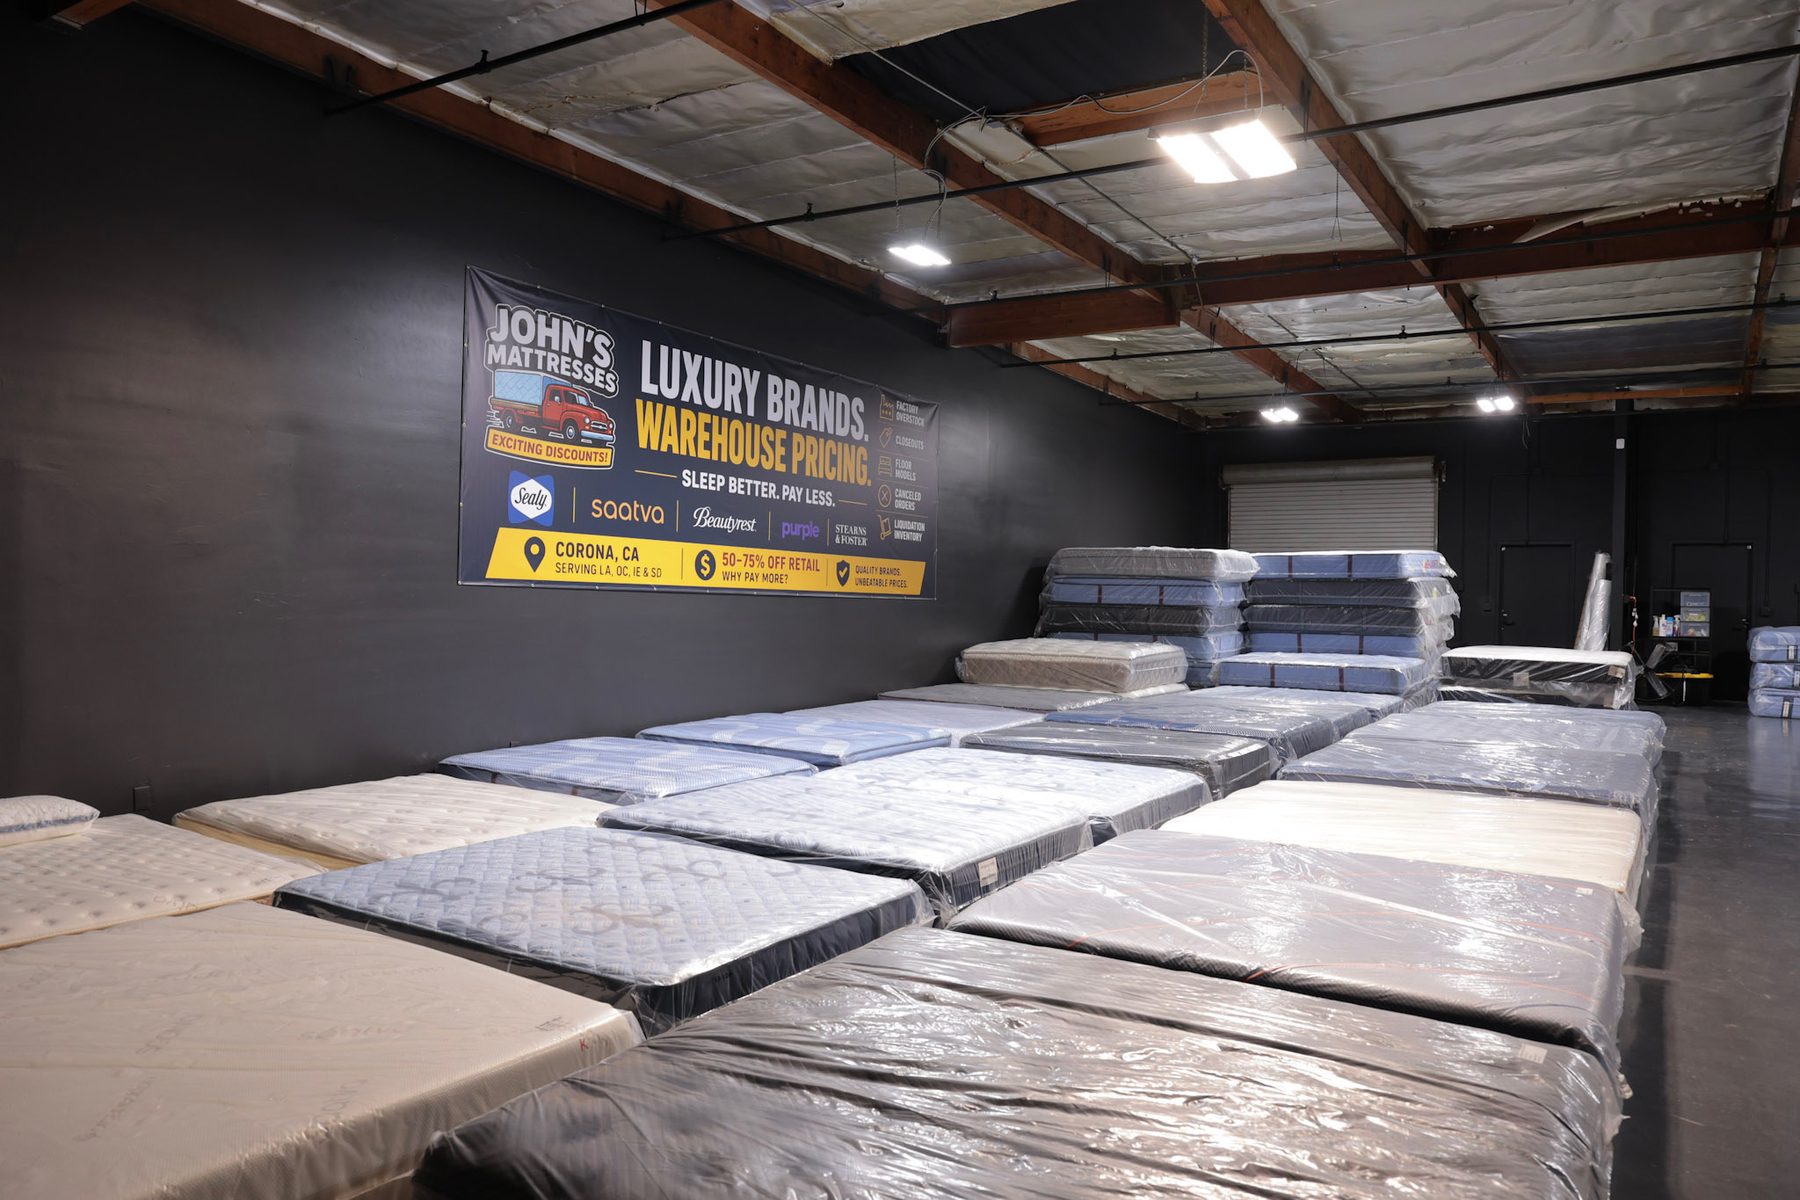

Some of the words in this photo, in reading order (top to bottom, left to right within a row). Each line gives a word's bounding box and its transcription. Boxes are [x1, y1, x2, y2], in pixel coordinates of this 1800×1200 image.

[490, 308, 611, 368] JOHN'S
[487, 344, 616, 393] MATTRESSES
[641, 340, 760, 417] LUXURY
[767, 373, 869, 442] BRANDS.
[896, 400, 919, 414] FACTORY
[896, 412, 925, 427] OVERSTOCK
[492, 434, 542, 456] EXCITING
[546, 447, 608, 463] DISCOUNTS!
[635, 398, 787, 472] WAREHOUSE
[792, 432, 872, 486] PRICING.
[895, 435, 924, 450] CLOSEOUTS
[895, 458, 912, 470] FLOOR
[895, 469, 916, 481] MODELS
[682, 469, 725, 491] SLEEP
[728, 476, 779, 500] BETTER.
[782, 485, 803, 502] PAY
[806, 489, 836, 507] LESS.
[895, 488, 922, 501] CANCELED
[514, 487, 547, 510] Sealy
[895, 499, 915, 511] ORDERS
[591, 498, 665, 524] saatva
[693, 506, 757, 533] Beautyrest
[894, 519, 925, 532] LIQUIDATION
[781, 520, 820, 541] purple
[835, 524, 867, 536] STEARNS
[894, 531, 923, 542] INVENTORY
[841, 536, 868, 546] FOSTER
[555, 542, 619, 562] CORONA,
[622, 546, 639, 562] CA
[722, 552, 765, 569] 50-75%
[767, 556, 786, 570] OFF
[789, 557, 820, 572] RETAIL
[555, 562, 597, 575] SERVING
[600, 564, 614, 577] LA,
[616, 566, 631, 577] OC,
[633, 567, 641, 577] IE
[643, 567, 649, 577] &
[651, 567, 662, 578] SD
[722, 571, 742, 582] WHY
[744, 572, 760, 583] PAY
[762, 573, 788, 584] MORE?
[856, 565, 878, 575] QUALITY
[879, 566, 902, 576] BRANDS.
[855, 577, 888, 587] UNBEATABLE
[889, 579, 909, 588] PRICES.
